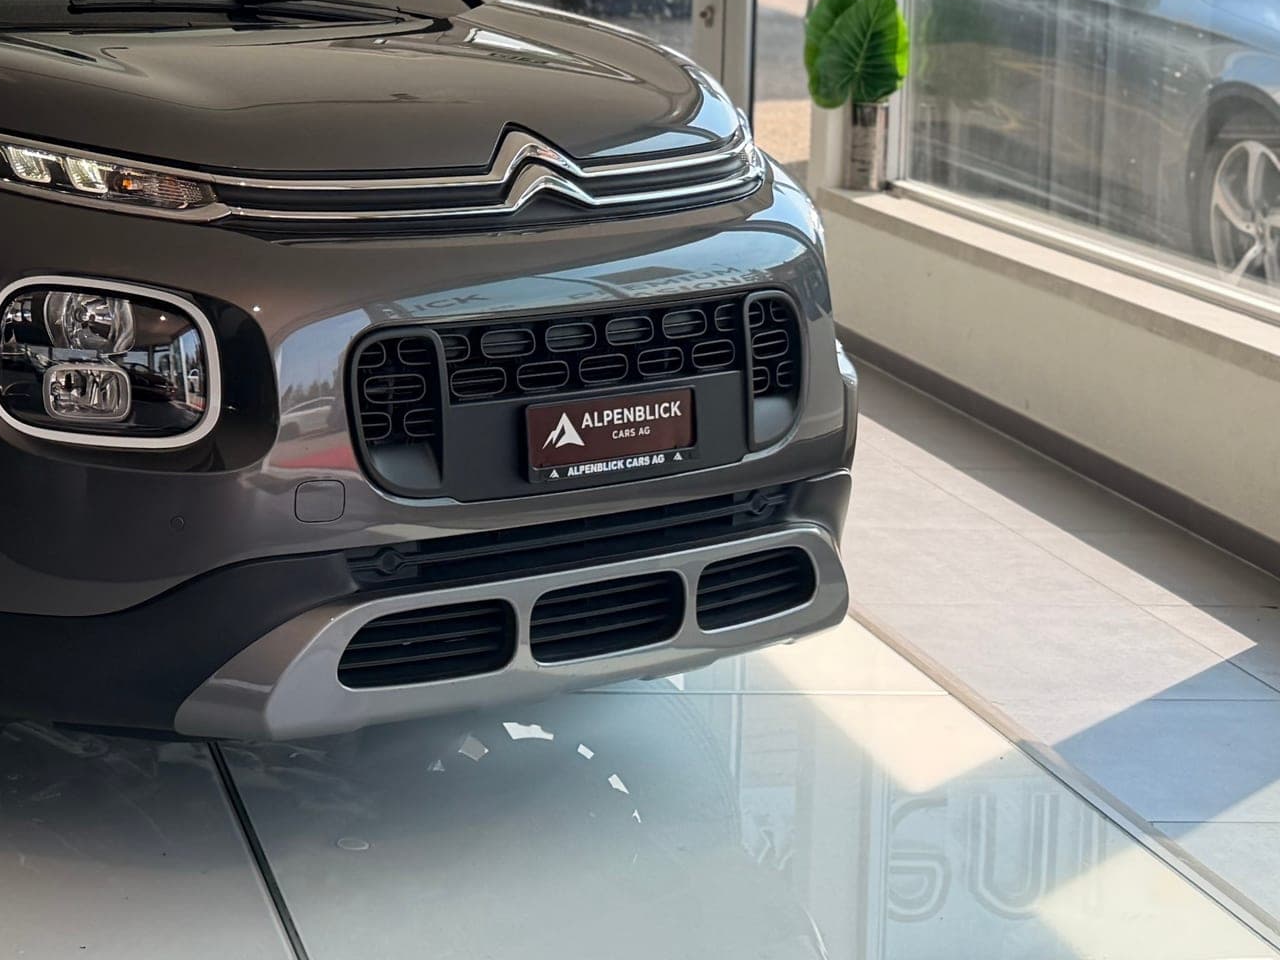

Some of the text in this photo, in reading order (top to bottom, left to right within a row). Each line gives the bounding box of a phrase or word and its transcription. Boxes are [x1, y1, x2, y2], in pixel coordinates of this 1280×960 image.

[581, 400, 682, 429] ALPENBLICK
[612, 426, 651, 440] CARS AG
[567, 453, 665, 477] ALPENBLICK CARS AG
